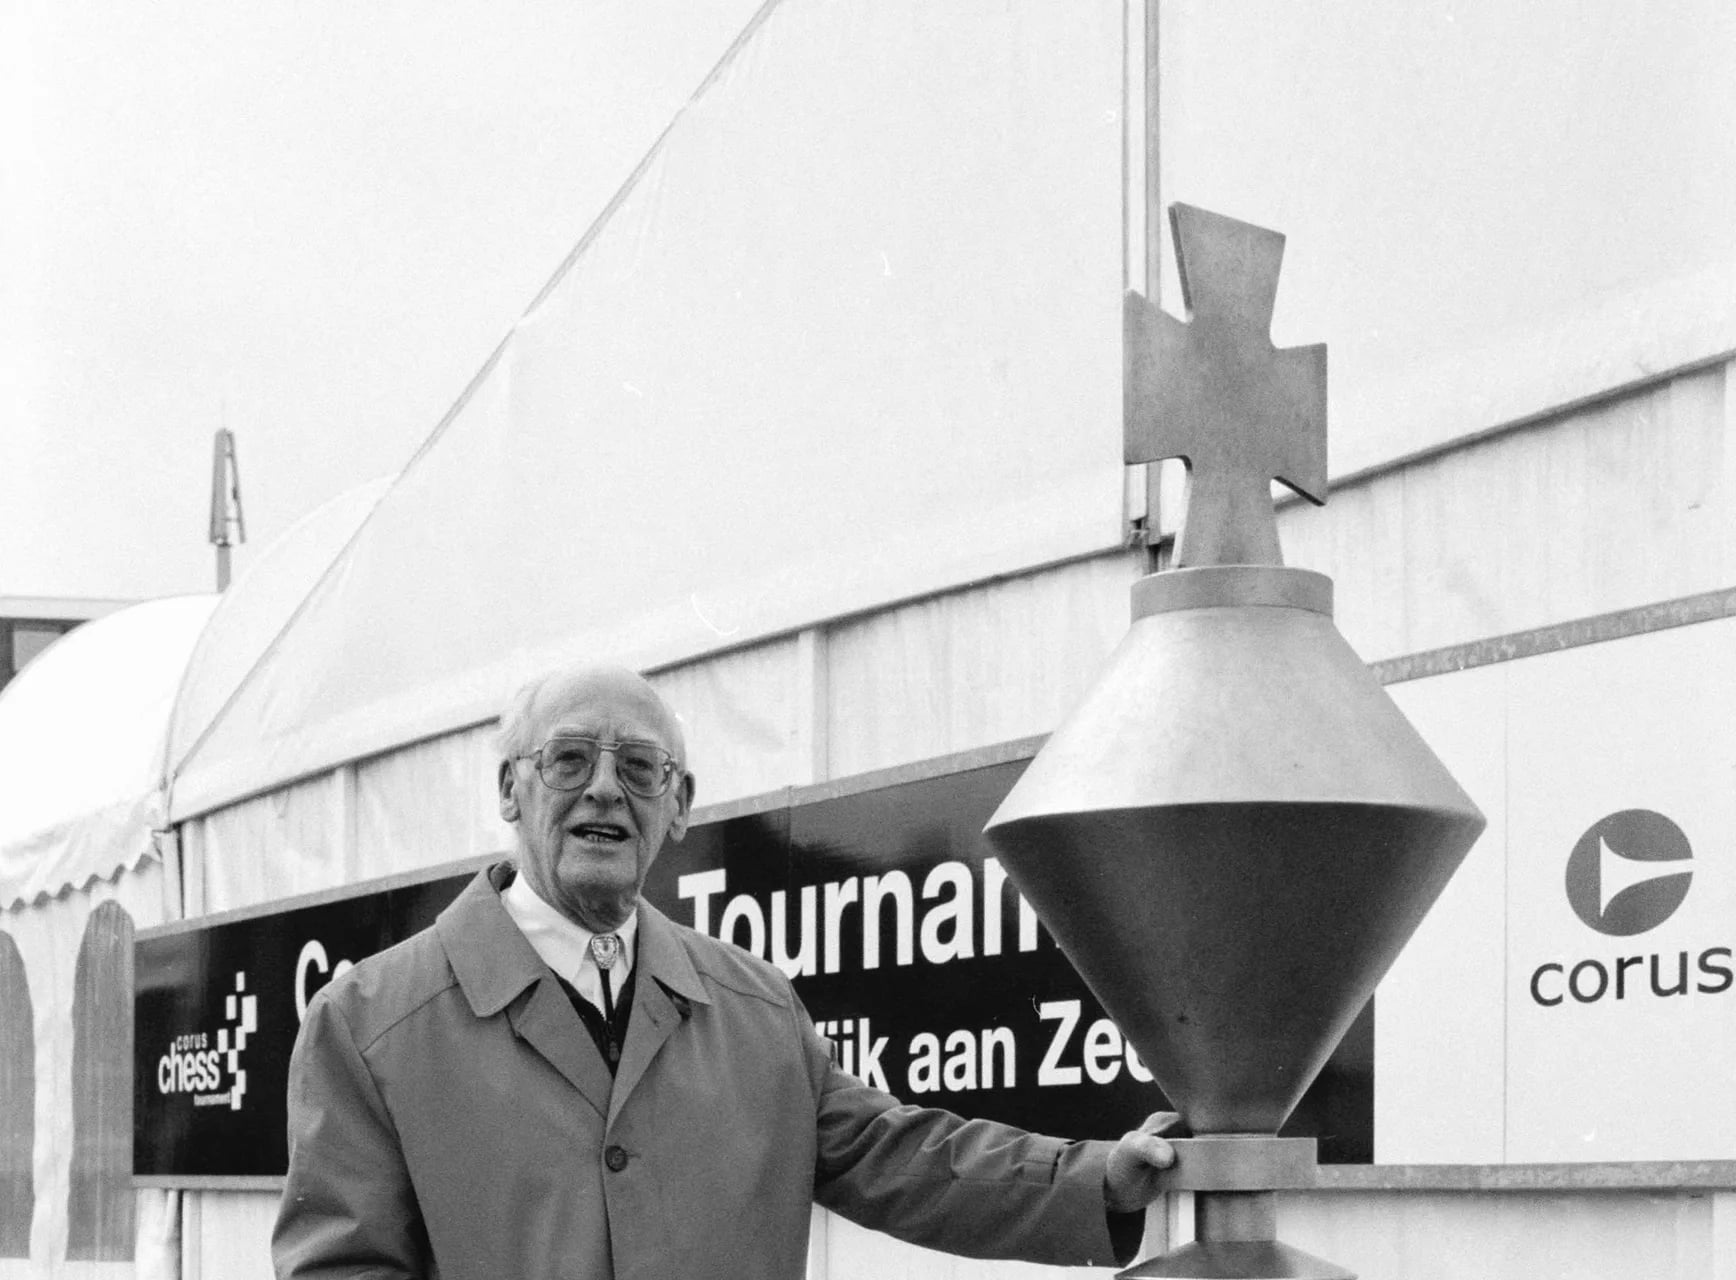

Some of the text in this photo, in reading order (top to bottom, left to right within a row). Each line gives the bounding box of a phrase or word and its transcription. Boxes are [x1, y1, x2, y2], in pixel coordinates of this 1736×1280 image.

[1530, 946, 1734, 1007] corus
[158, 1041, 220, 1094] chess
[176, 1032, 208, 1051] corus
[908, 1026, 1016, 1093] aan
